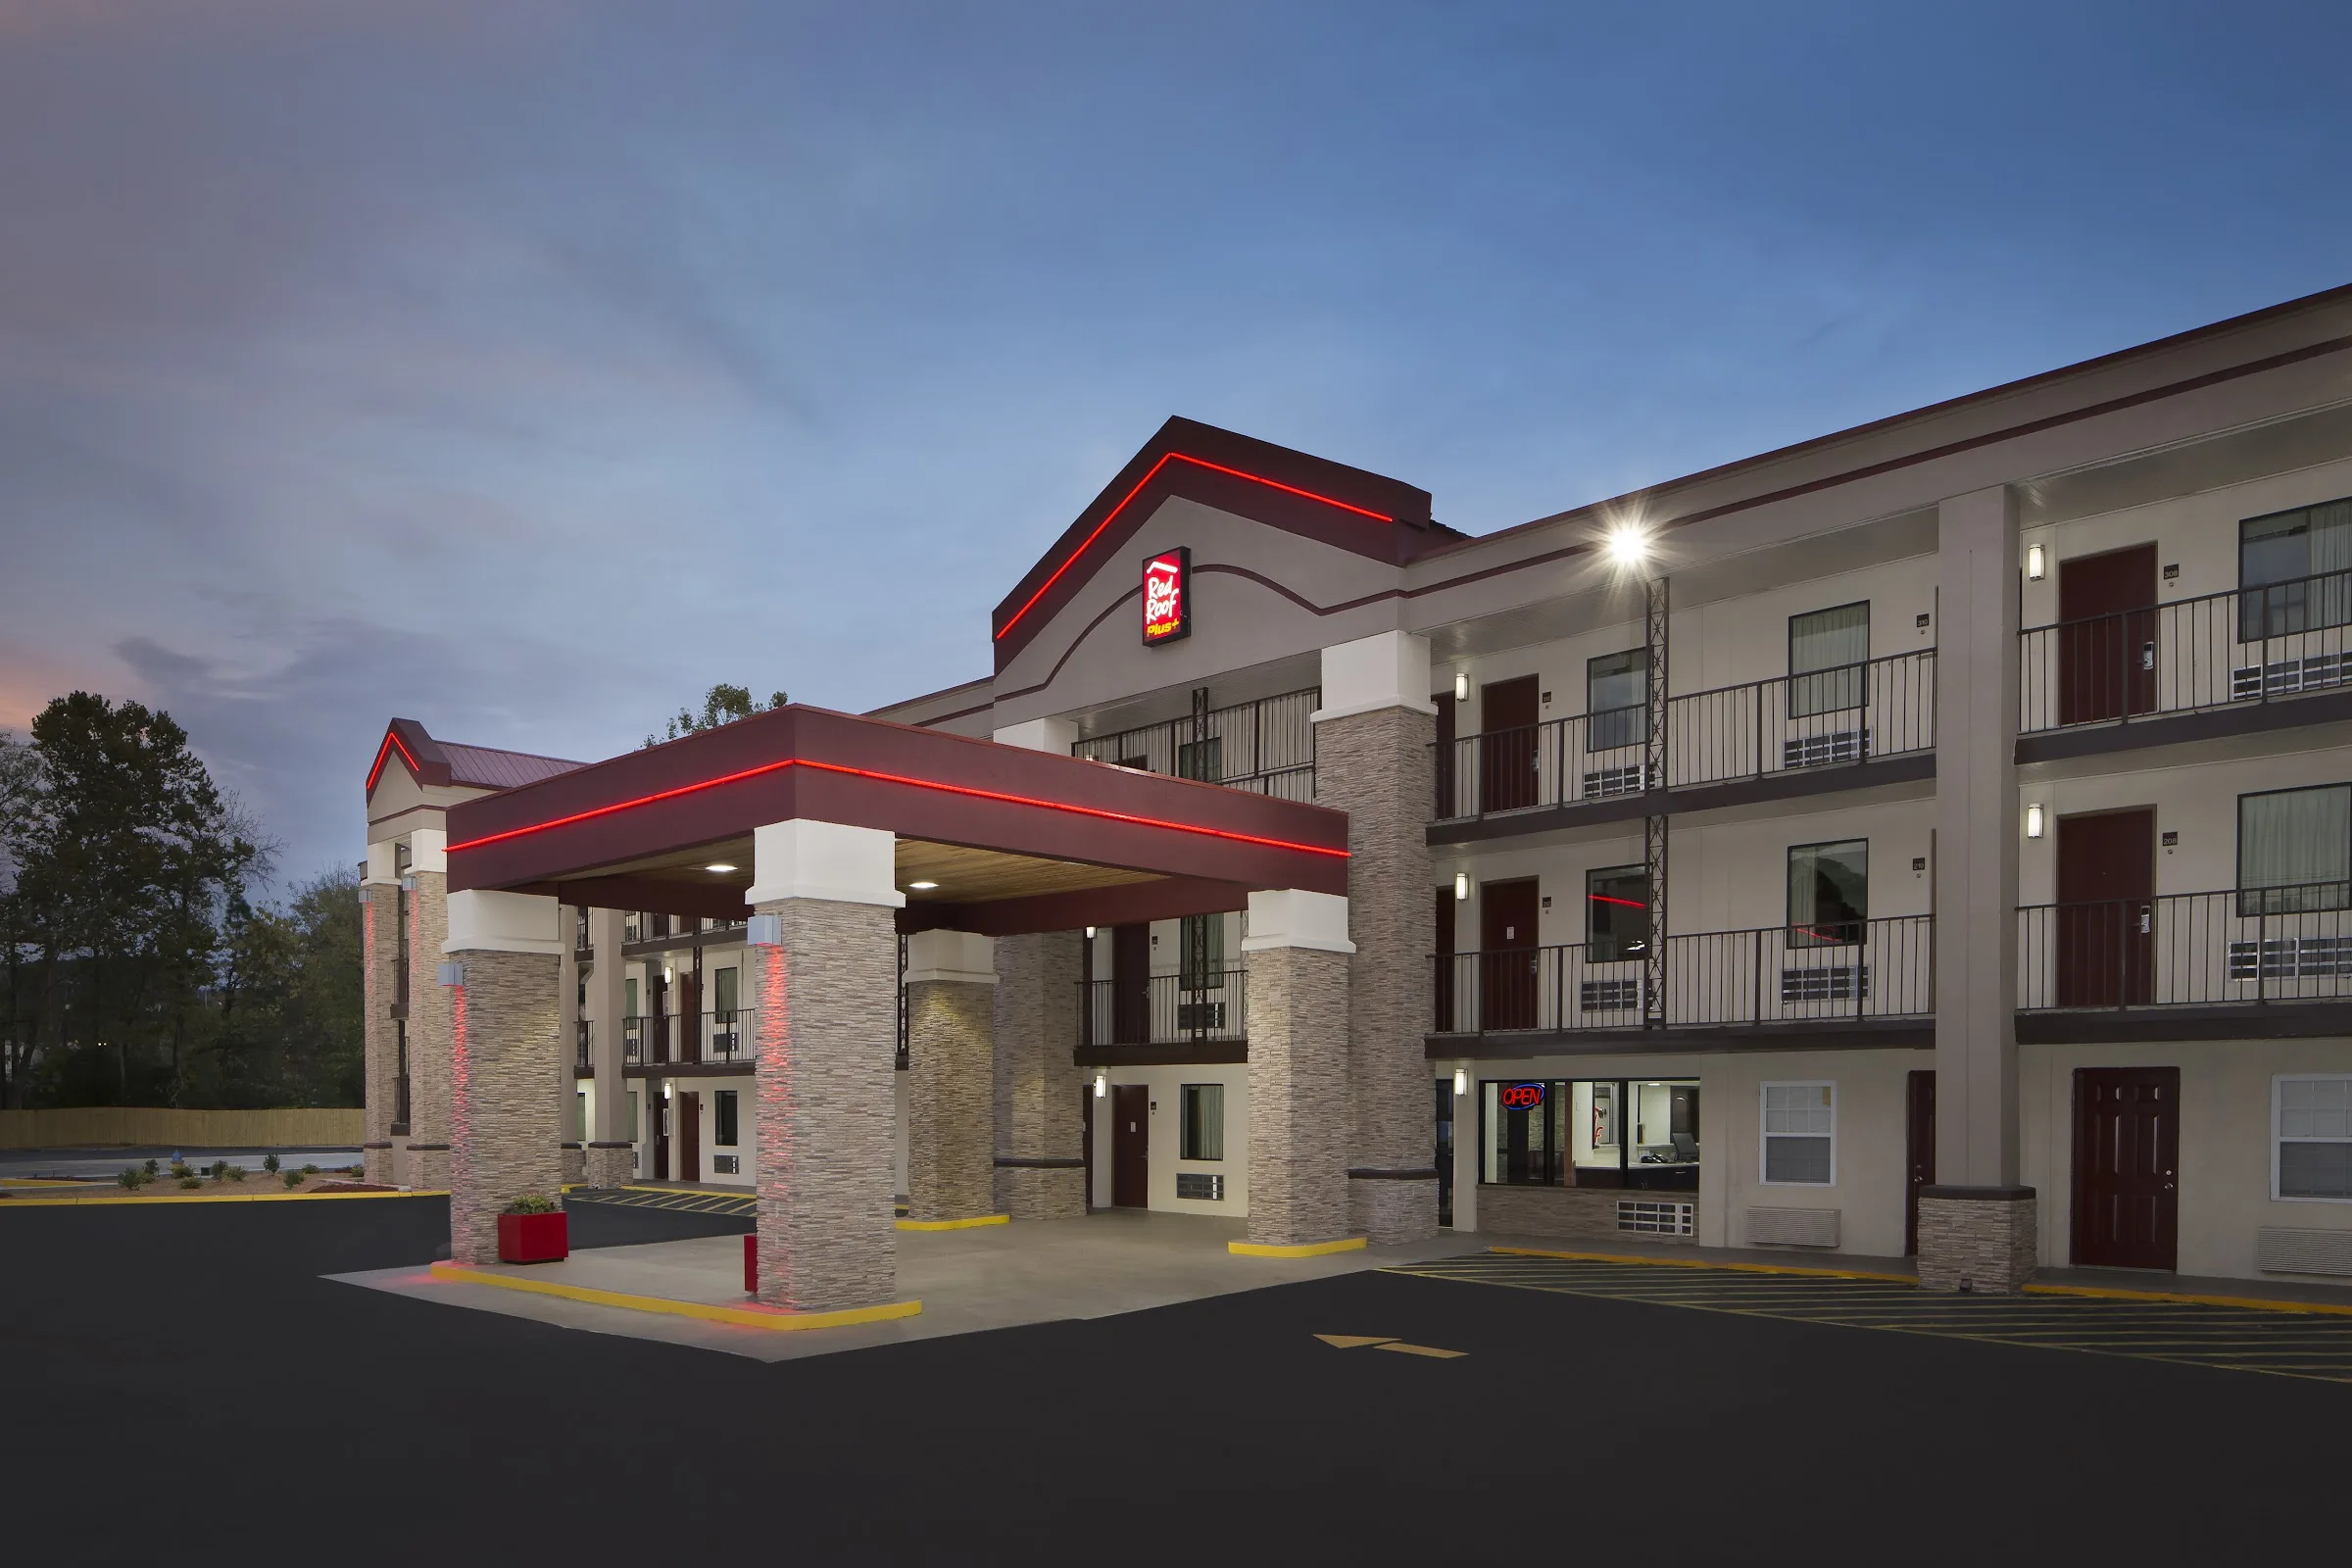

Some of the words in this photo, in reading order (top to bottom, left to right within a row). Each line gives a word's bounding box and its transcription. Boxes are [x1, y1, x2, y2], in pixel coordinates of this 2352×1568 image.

[1149, 575, 1173, 600] Red
[1146, 588, 1179, 624] Roof
[1502, 1088, 1542, 1104] OPEN
